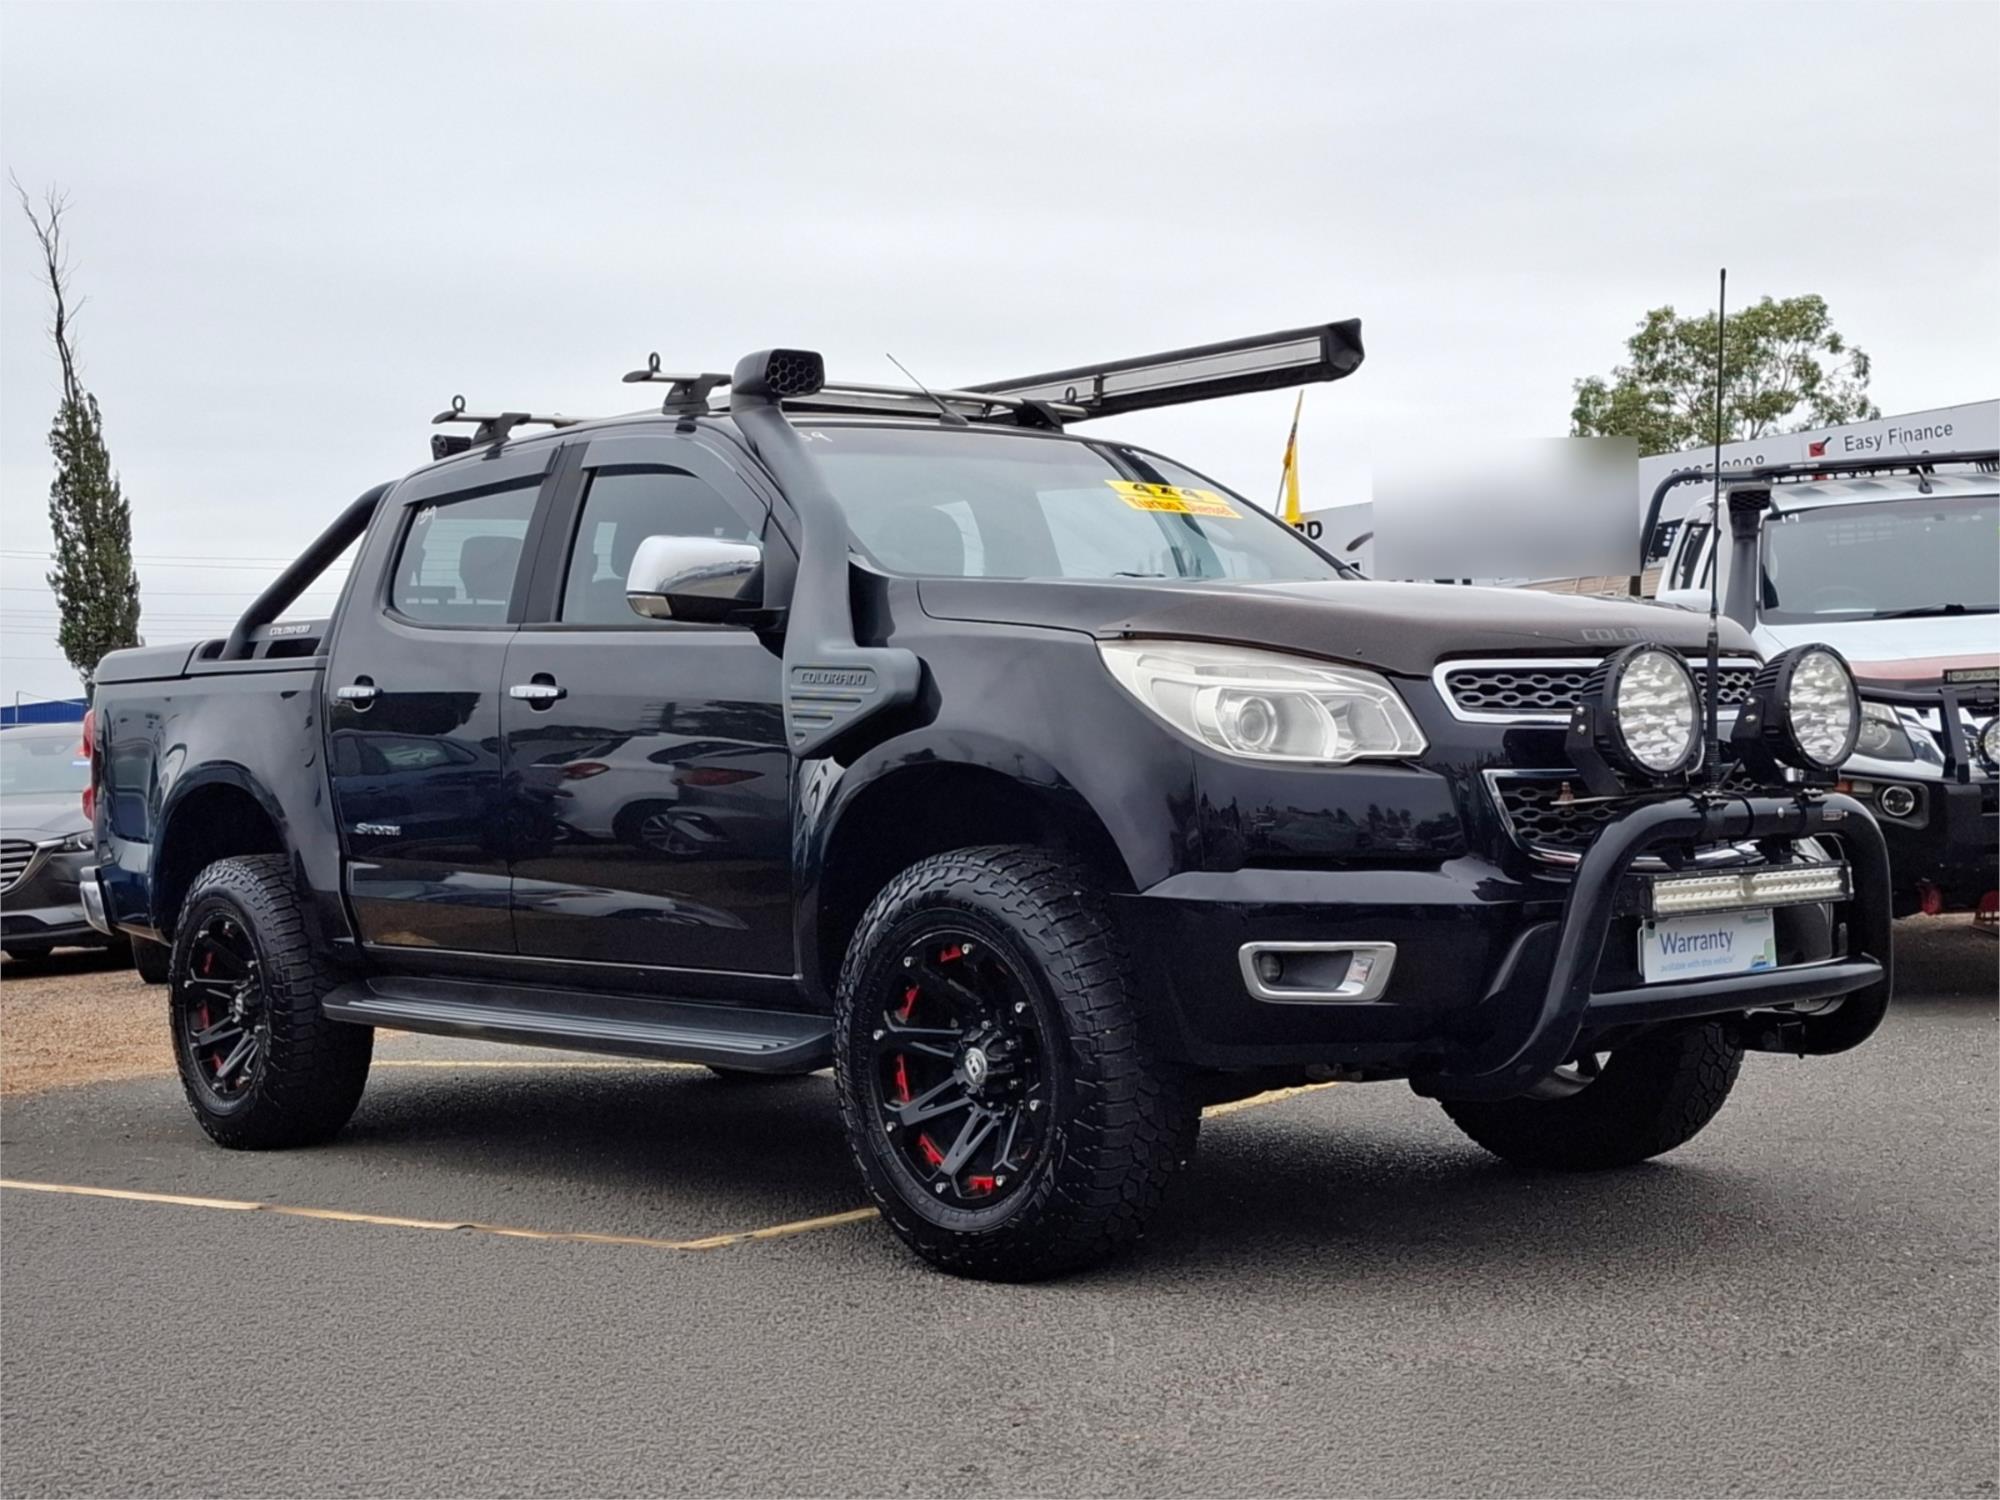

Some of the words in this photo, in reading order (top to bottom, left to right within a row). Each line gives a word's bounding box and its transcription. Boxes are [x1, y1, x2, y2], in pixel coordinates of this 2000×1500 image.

[1844, 434, 1882, 452] Easy
[1888, 423, 1953, 445] Finance
[801, 672, 867, 686] COLORADO
[1659, 927, 1734, 956] Warranty
